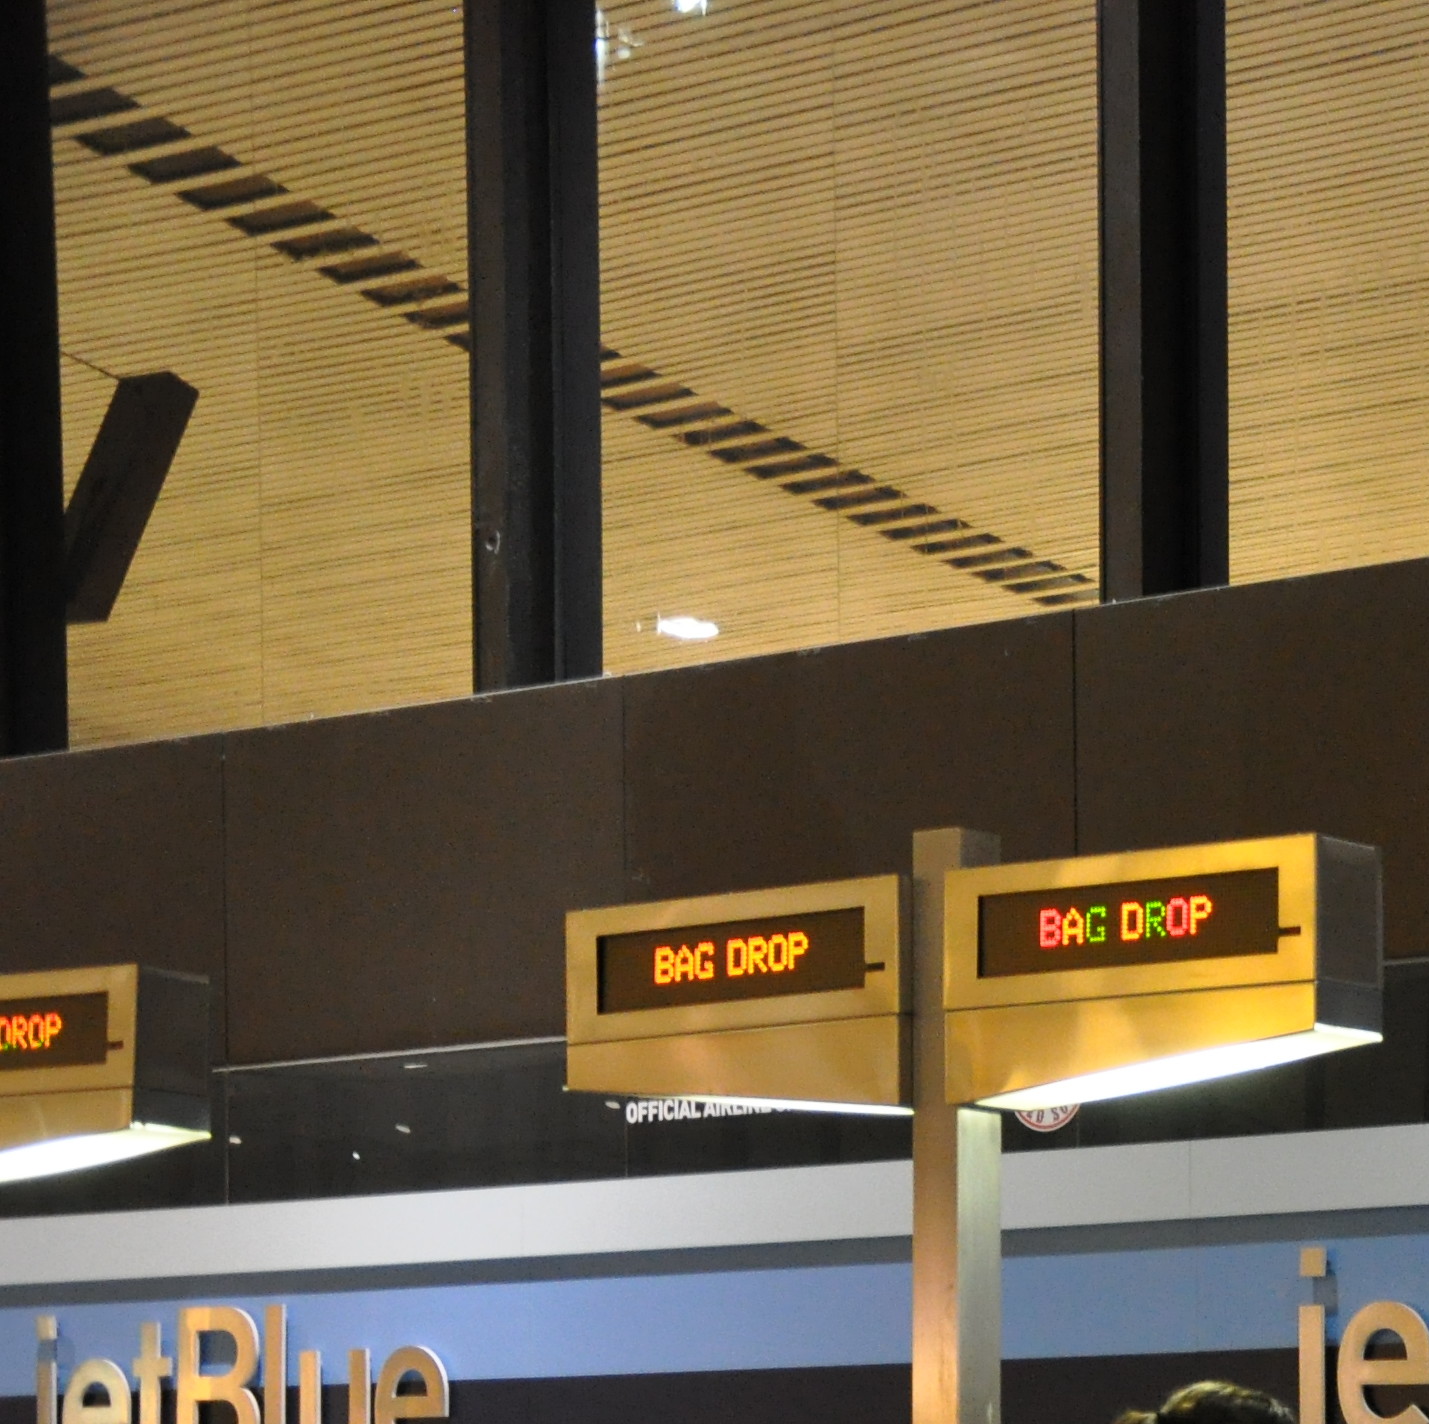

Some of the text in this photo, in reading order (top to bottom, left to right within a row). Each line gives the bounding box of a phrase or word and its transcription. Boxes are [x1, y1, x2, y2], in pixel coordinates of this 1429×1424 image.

[1039, 895, 1213, 948] BAG DROP
[653, 930, 810, 985] BAG DROP
[626, 1099, 702, 1124] OFFICIAL
